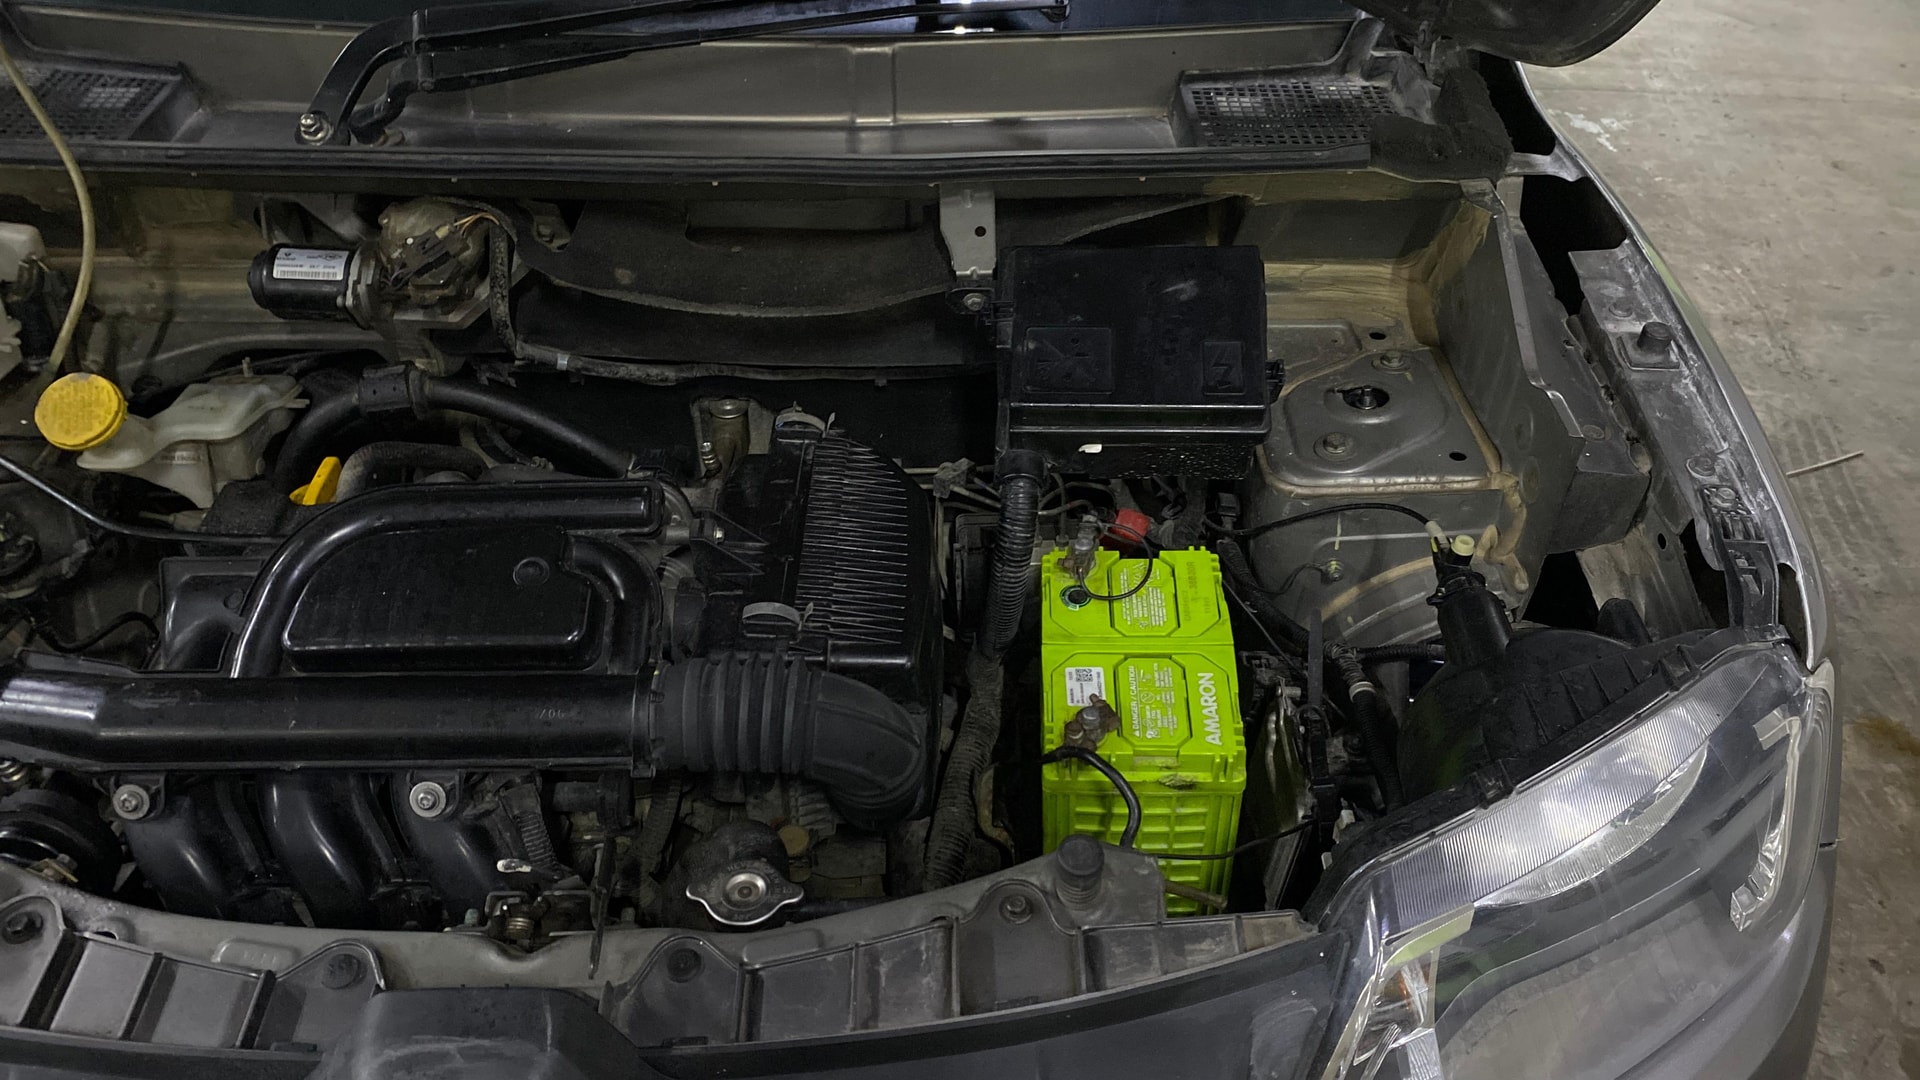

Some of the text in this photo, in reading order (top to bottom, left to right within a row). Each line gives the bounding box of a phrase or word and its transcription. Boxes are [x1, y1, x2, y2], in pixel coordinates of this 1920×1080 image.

[1129, 666, 1137, 695] CAUTION
[1131, 702, 1139, 729] DANGER
[1198, 673, 1222, 745] AMARON
